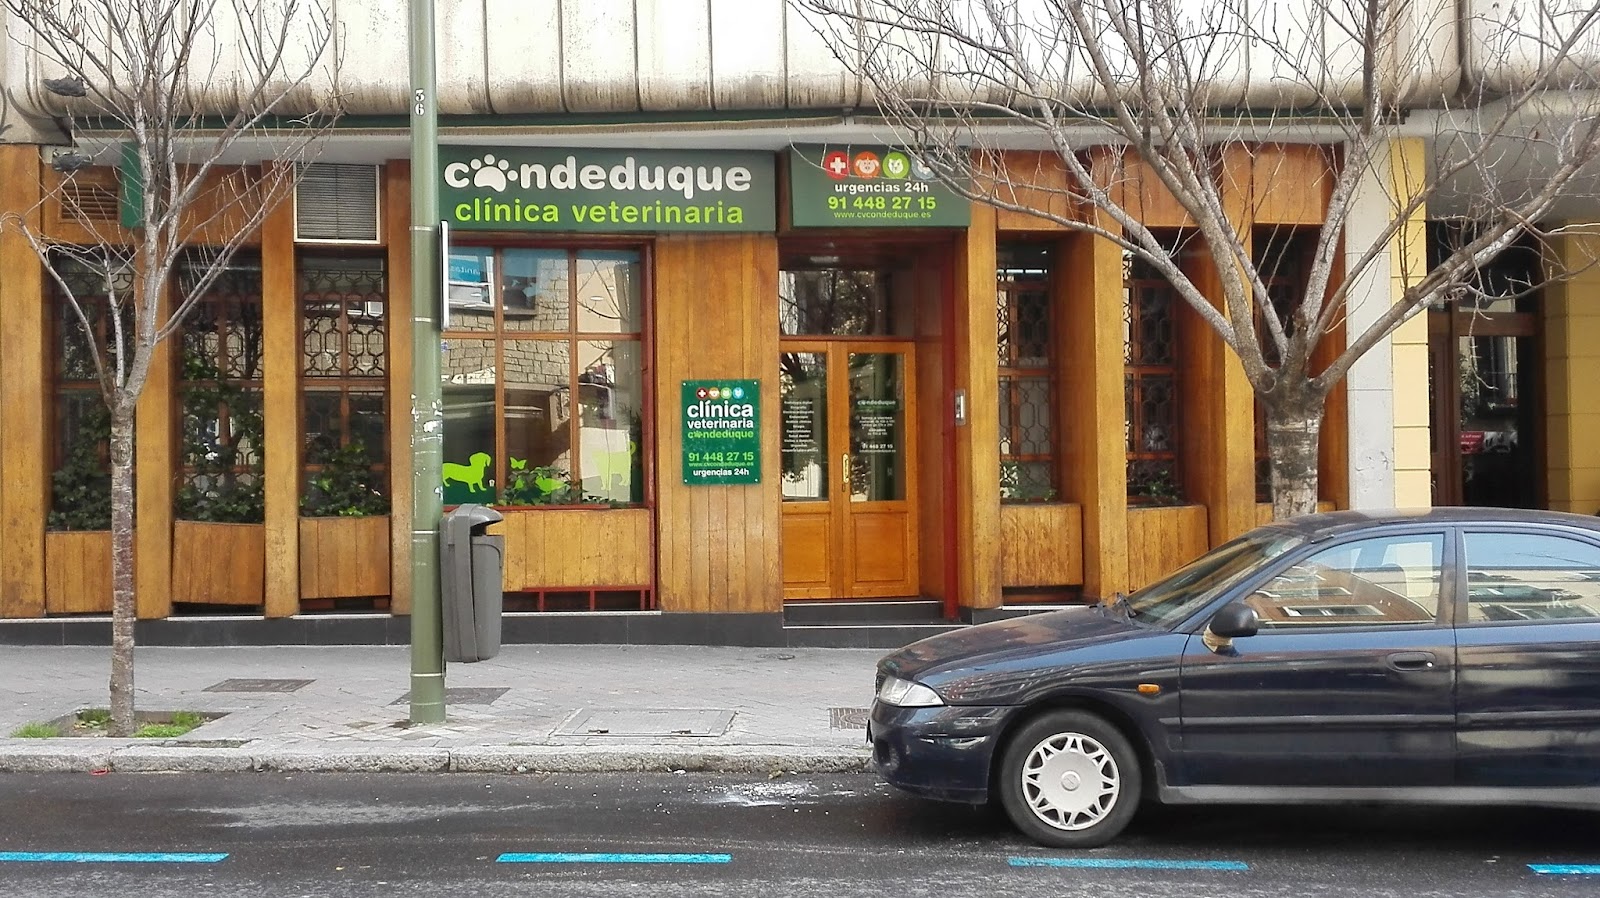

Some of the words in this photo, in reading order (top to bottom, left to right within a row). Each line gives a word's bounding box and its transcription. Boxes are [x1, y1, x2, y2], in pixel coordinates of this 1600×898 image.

[834, 182, 900, 195] urgencias
[904, 182, 929, 193] 24h
[828, 196, 847, 210] 91
[853, 196, 885, 210] 448
[892, 196, 911, 210] 27
[918, 196, 936, 210] 15
[455, 197, 559, 223] clínica
[571, 200, 743, 223] veterinaria
[833, 211, 931, 219] www.cvcondeduque.es
[687, 400, 754, 418] clínica
[687, 418, 754, 429] veterinaria
[688, 452, 700, 462] 91
[703, 452, 723, 462] 448
[726, 452, 740, 461] 27
[742, 451, 754, 461] 15
[693, 468, 732, 478] urgencias
[733, 468, 750, 476] 24h
